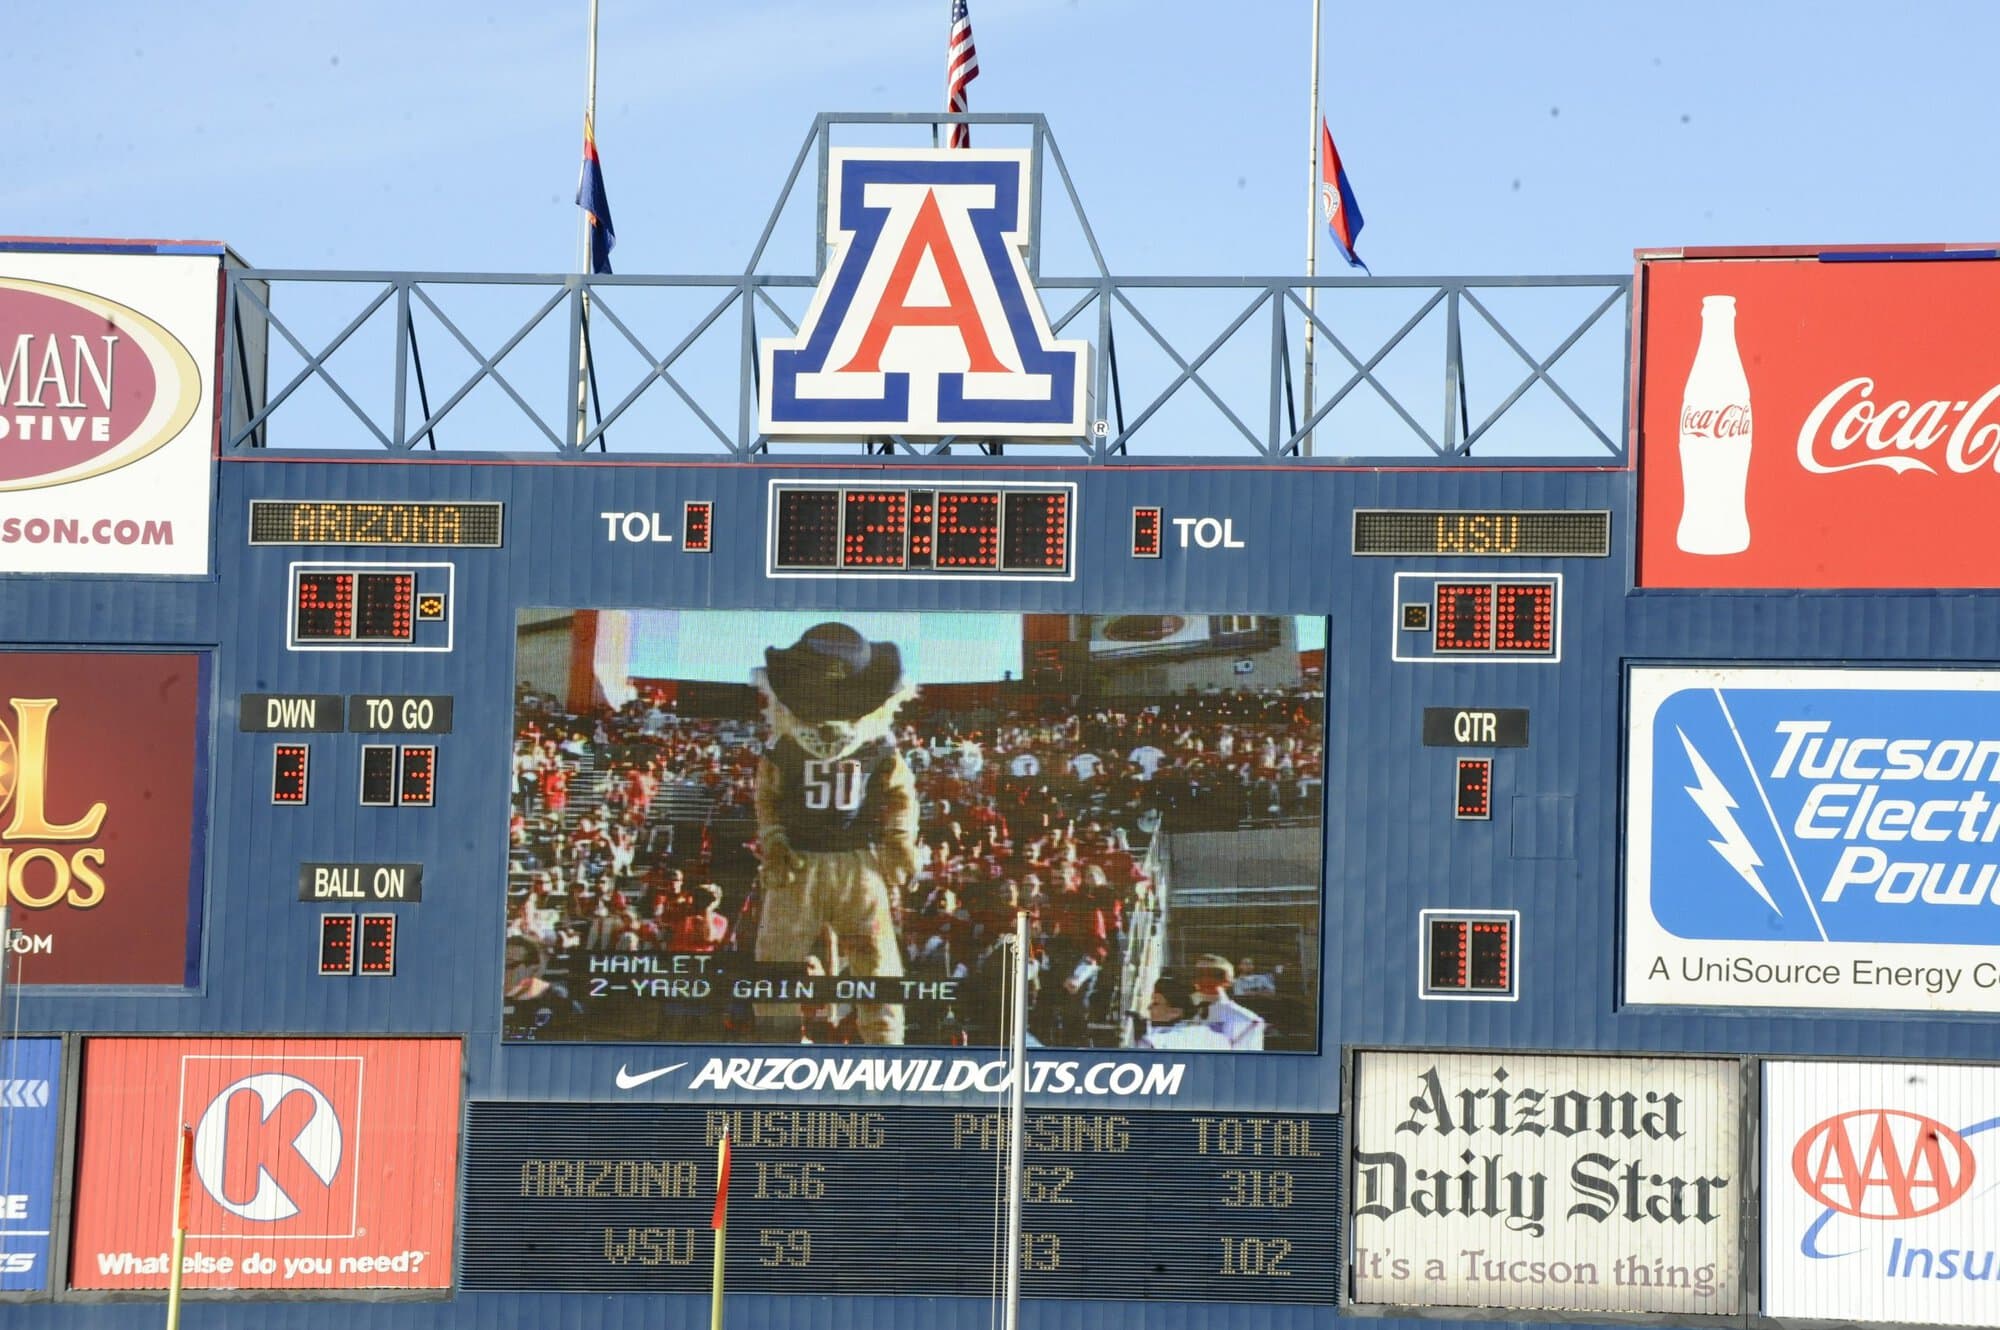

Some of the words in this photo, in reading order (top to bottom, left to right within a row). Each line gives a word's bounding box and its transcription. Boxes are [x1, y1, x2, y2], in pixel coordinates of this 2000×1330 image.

[770, 158, 1077, 424] A
[1682, 403, 1751, 439] Coca-Cola
[1796, 376, 2000, 476] Coca-C
[1, 517, 174, 545] SON.COM
[292, 503, 461, 544] ARIZONA
[601, 511, 672, 543] TOL
[687, 506, 710, 549] 3
[844, 493, 1064, 567] 2:51
[1134, 511, 1160, 554] 3
[1173, 517, 1244, 549] TOL
[1436, 515, 1518, 553] WSU
[1438, 586, 1552, 648] 00
[266, 698, 317, 729] DWN
[366, 699, 394, 729] TO
[401, 699, 434, 730] GO
[1454, 711, 1497, 743] QTR
[0, 697, 108, 841] L
[1770, 720, 2000, 782] Tucson
[275, 748, 306, 800] 3
[403, 749, 434, 801] 3
[803, 759, 861, 811] 50
[1457, 761, 1489, 815] 3
[314, 867, 366, 898] BALL
[373, 868, 405, 898] ON
[1820, 846, 2000, 906] Pow
[5, 932, 53, 954] OM
[589, 955, 725, 975] HAMLET.
[589, 978, 711, 1000] 2-YARD
[732, 980, 814, 1000] GAIN
[836, 981, 876, 1000] ON
[902, 981, 958, 1001] THE
[1648, 956, 1670, 981] A
[1682, 957, 1841, 985] UniSource
[1852, 960, 1962, 994] Energy
[1973, 962, 2000, 989] C
[688, 1058, 1186, 1096] ARIZONAWILDCATS.COM
[1394, 1064, 1687, 1142] Arizona
[705, 1110, 887, 1149] RUSHING
[1191, 1117, 1320, 1157] TOTAL
[520, 1160, 698, 1199] ARIZONA
[753, 1161, 826, 1200] 156
[1221, 1169, 1294, 1209] 318
[1808, 1111, 1956, 1219] AAA
[0, 1194, 29, 1219] E
[1353, 1144, 1549, 1238] Daily
[1566, 1152, 1730, 1226] Star
[97, 1253, 170, 1275] What
[182, 1253, 234, 1274] else
[241, 1253, 277, 1275] do
[284, 1257, 332, 1279] you
[339, 1251, 425, 1274] need?
[604, 1227, 696, 1267] WSU
[760, 1229, 812, 1267] 59
[1220, 1236, 1292, 1277] 102
[1355, 1247, 1410, 1281] It's
[1424, 1258, 1446, 1281] a
[1460, 1249, 1600, 1285] Tucson
[1613, 1254, 1726, 1298] thing.
[1886, 1237, 2000, 1282] Insu
